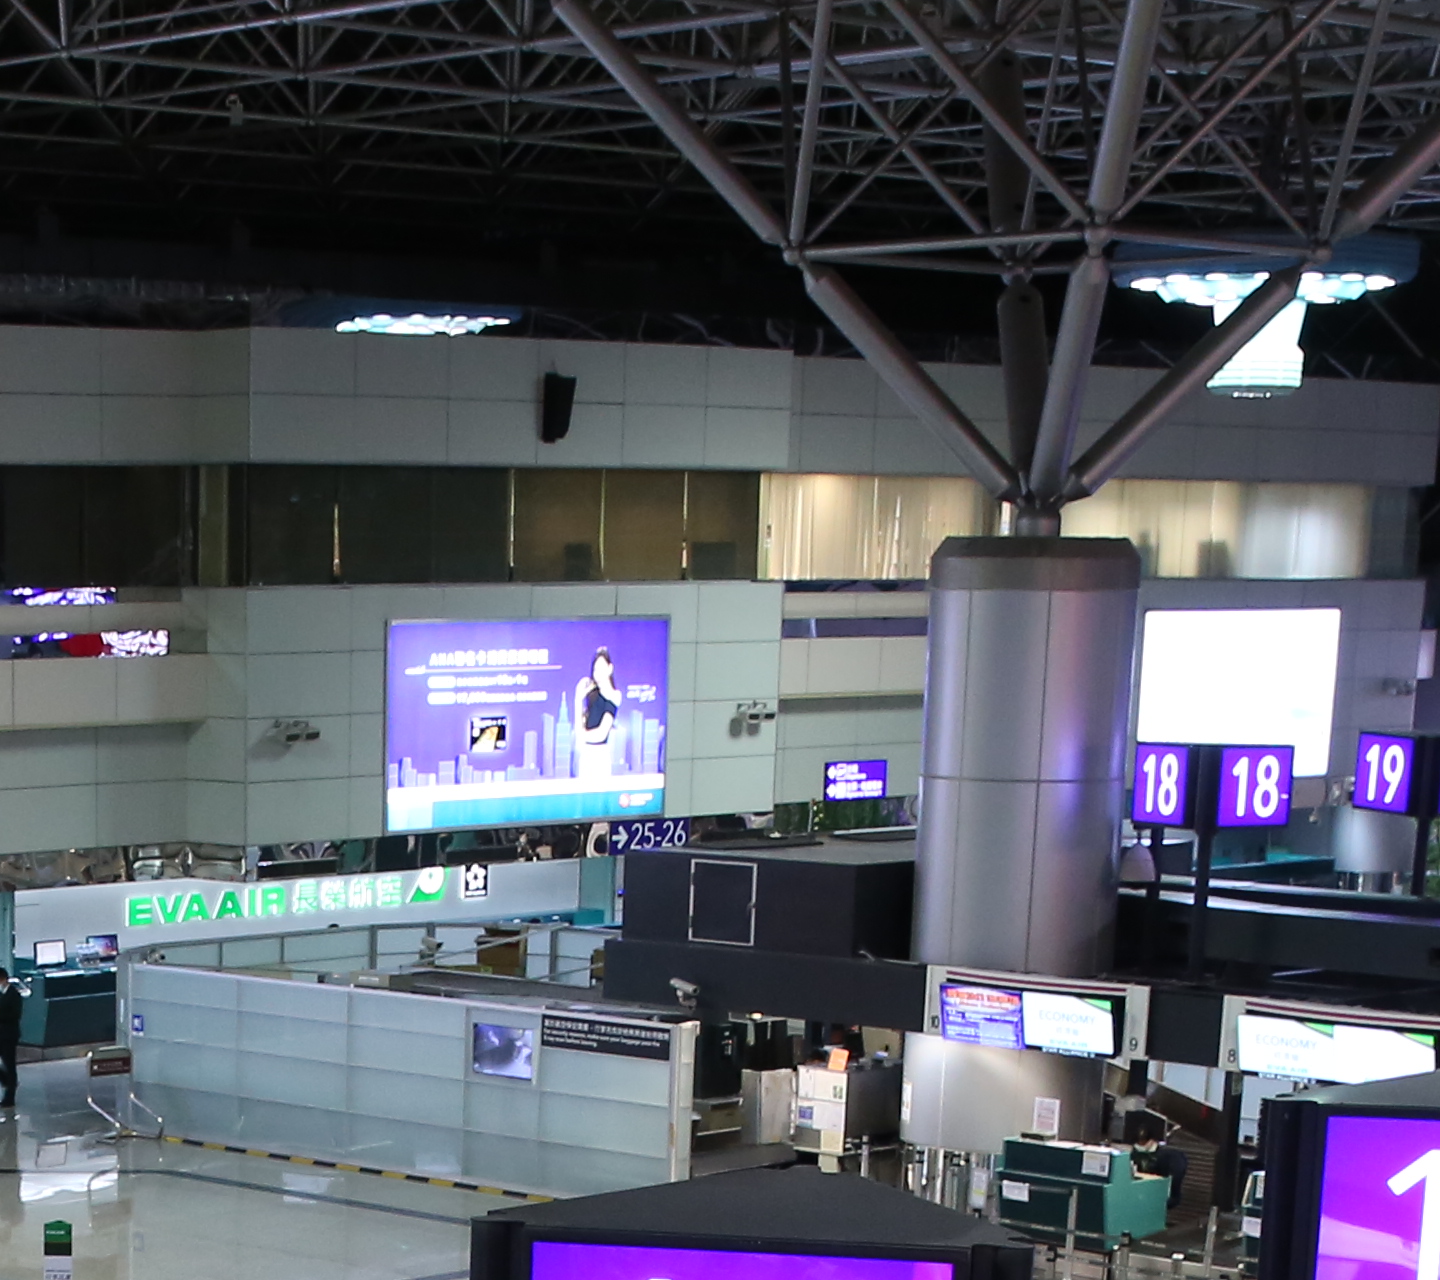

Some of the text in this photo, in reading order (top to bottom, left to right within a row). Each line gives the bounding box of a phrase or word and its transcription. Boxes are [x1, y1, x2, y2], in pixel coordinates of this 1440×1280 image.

[1142, 752, 1180, 817] 18
[1231, 754, 1281, 819] 18
[1364, 743, 1406, 805] 19
[630, 819, 687, 850] 25-26
[125, 877, 403, 926] EVA AIR 長榮航空
[1038, 1009, 1096, 1025] ECONOMY
[1129, 1037, 1139, 1051] 9
[1227, 1049, 1237, 1064] 8
[1255, 1033, 1319, 1051] ECONOMY
